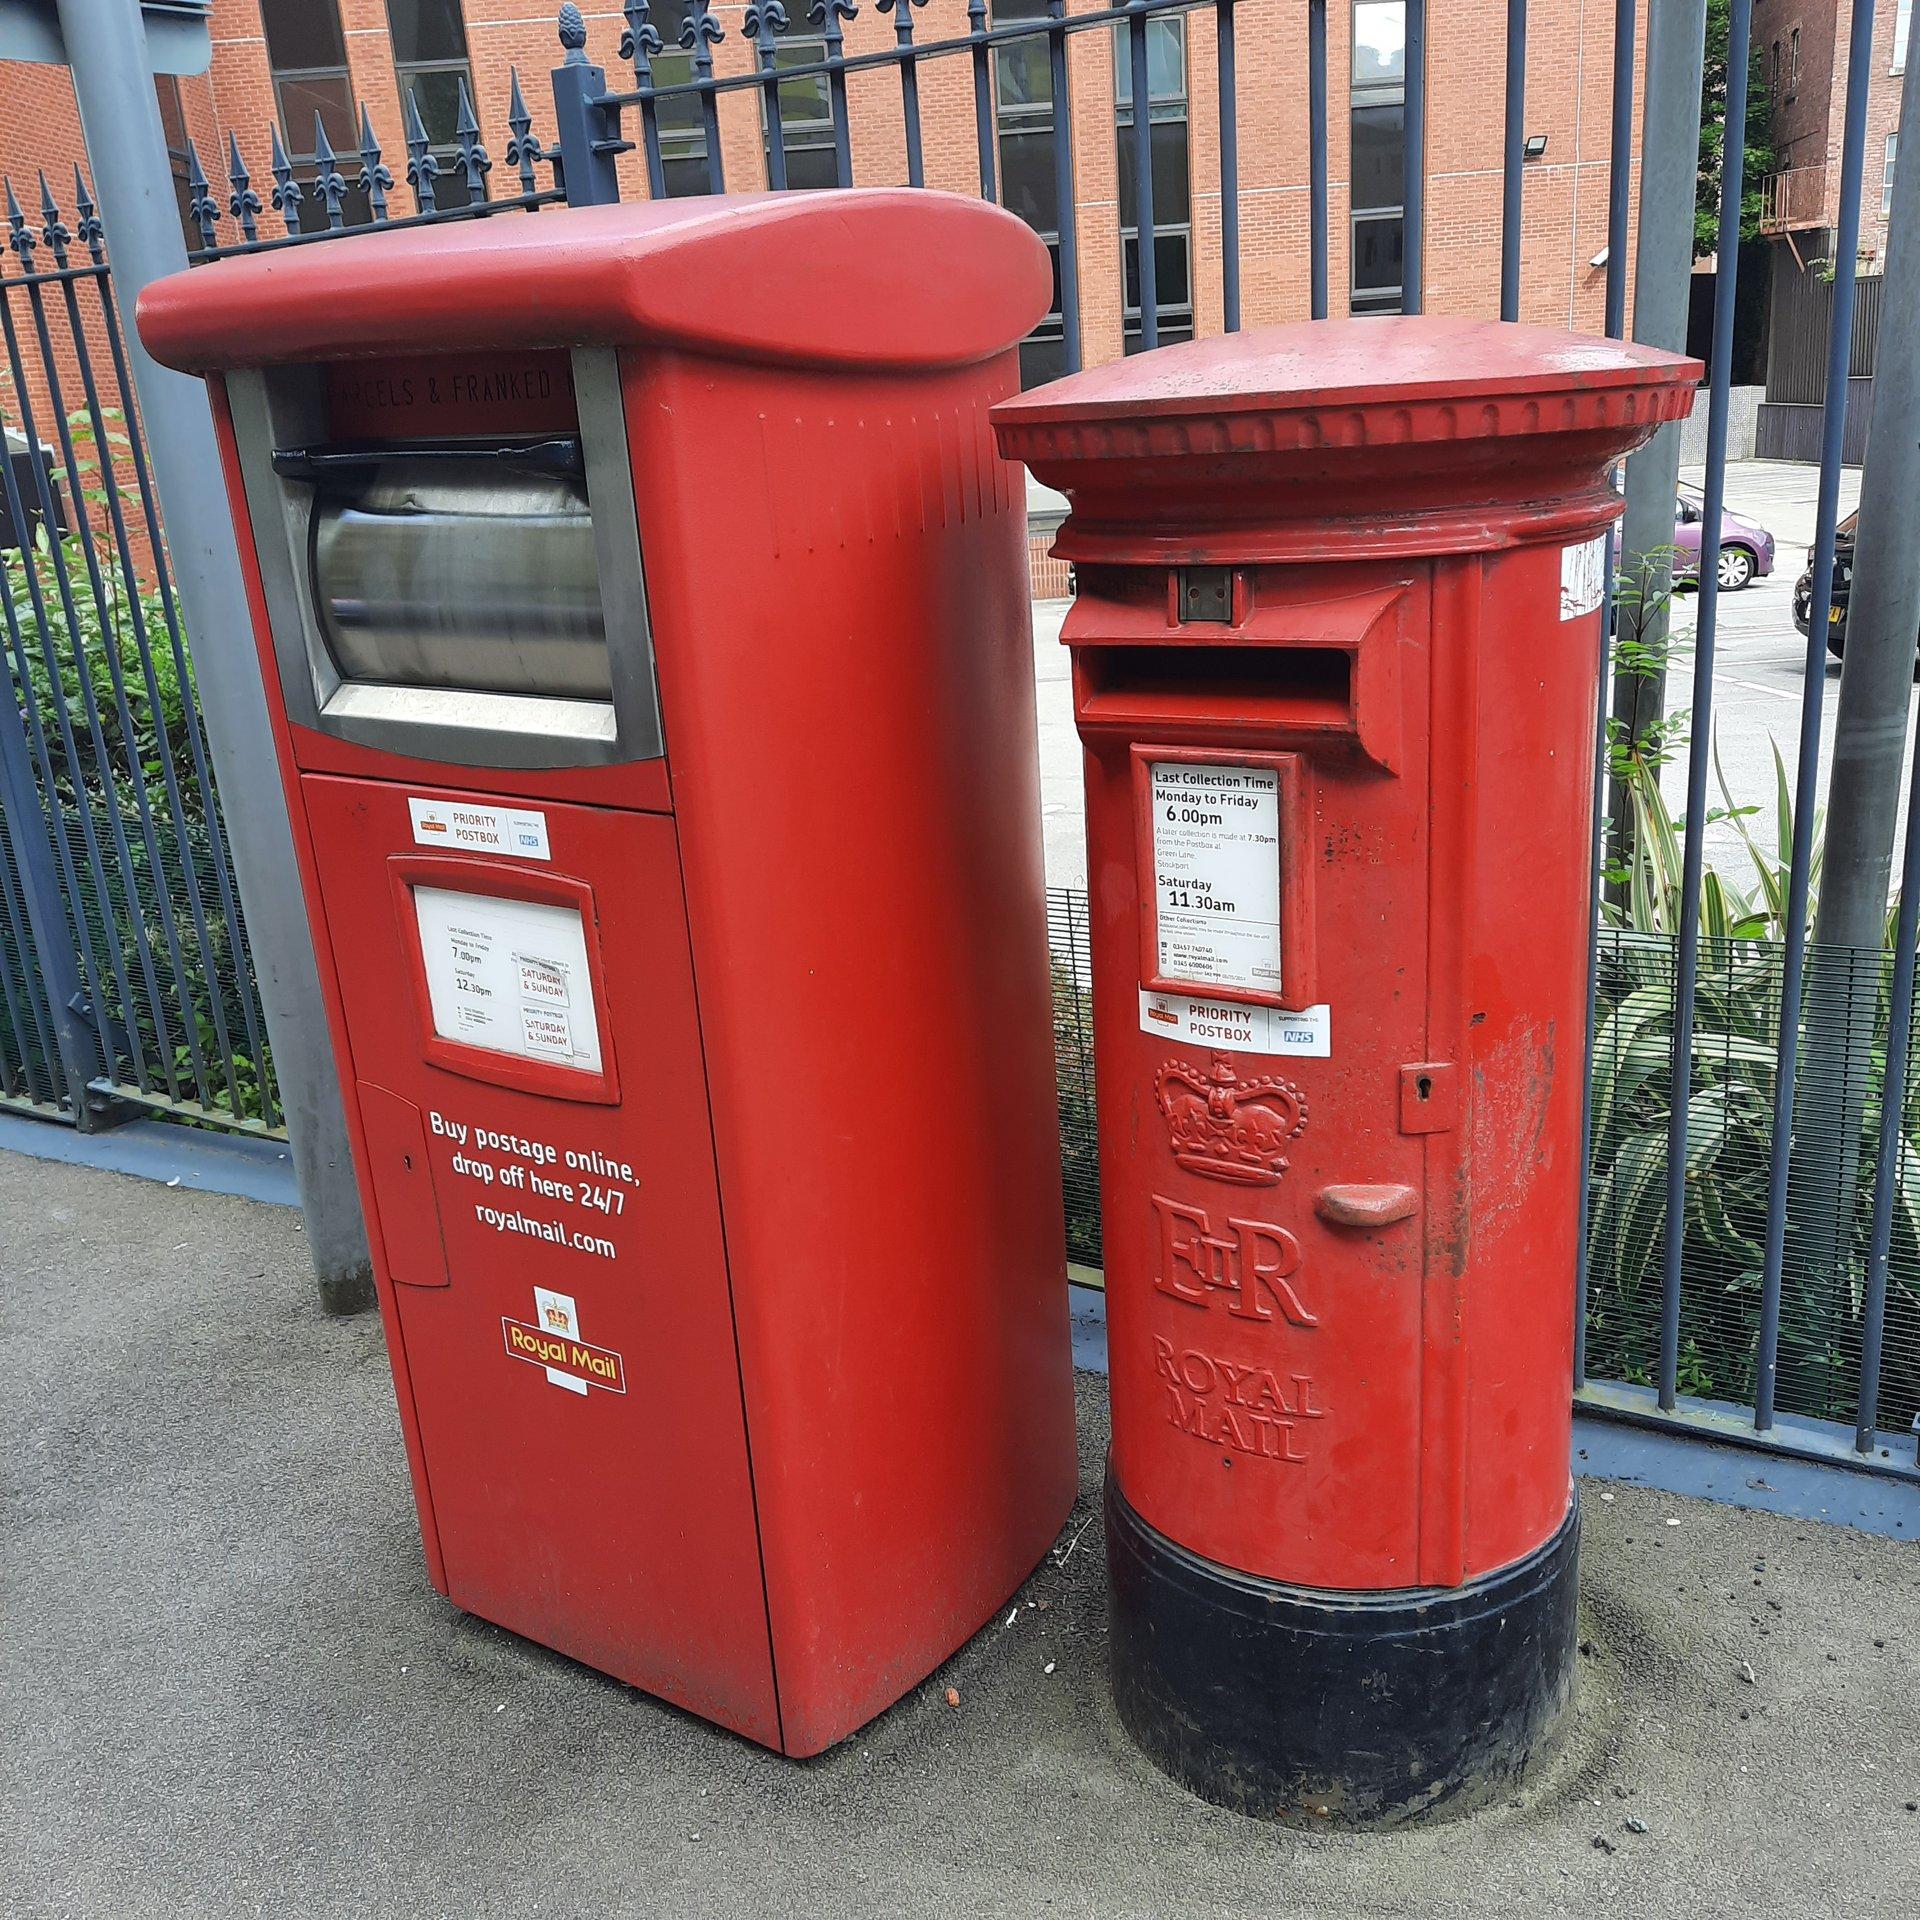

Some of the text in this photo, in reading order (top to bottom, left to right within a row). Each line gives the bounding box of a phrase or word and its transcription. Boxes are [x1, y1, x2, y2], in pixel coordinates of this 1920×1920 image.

[429, 377, 440, 404] &
[453, 369, 551, 403] FRANKED
[1155, 771, 1274, 790] Last Collection Time
[1156, 789, 1259, 810] Monday to Friday
[453, 812, 496, 828] PRIORITY
[1166, 805, 1222, 826] 6.00pm
[456, 829, 500, 845] POSTBOX
[519, 834, 539, 847] NHS
[1156, 836, 1221, 849] from the Postbox at
[1162, 827, 1178, 835] later
[1179, 829, 1210, 838] collection
[1218, 832, 1238, 841] made
[1247, 833, 1277, 844] 7.30pm
[1157, 848, 1178, 858] Green
[1157, 860, 1189, 870] Stockport
[1158, 875, 1212, 893] Saturday
[1168, 891, 1236, 912] 11.30am
[1159, 914, 1207, 925] Other Collections
[452, 946, 482, 964] 7.00pm
[521, 967, 562, 986] SATURDAY
[456, 977, 492, 997] 12.30pm
[523, 980, 564, 998] & SUNDAY
[1189, 1004, 1252, 1024] PRIORITY
[525, 1018, 567, 1036] SATURDAY
[1190, 1022, 1252, 1042] POSTBOX
[1284, 1031, 1313, 1042] NHS
[527, 1031, 568, 1047] & SUNDAY
[429, 1110, 640, 1187] Buy postage online,
[452, 1151, 625, 1215] drop off here 24/7
[474, 1204, 616, 1259] royalmail.com
[510, 1326, 617, 1380] Royal Mail
[1152, 1332, 1325, 1419] ROYAL
[1166, 1383, 1308, 1463] MAIL
